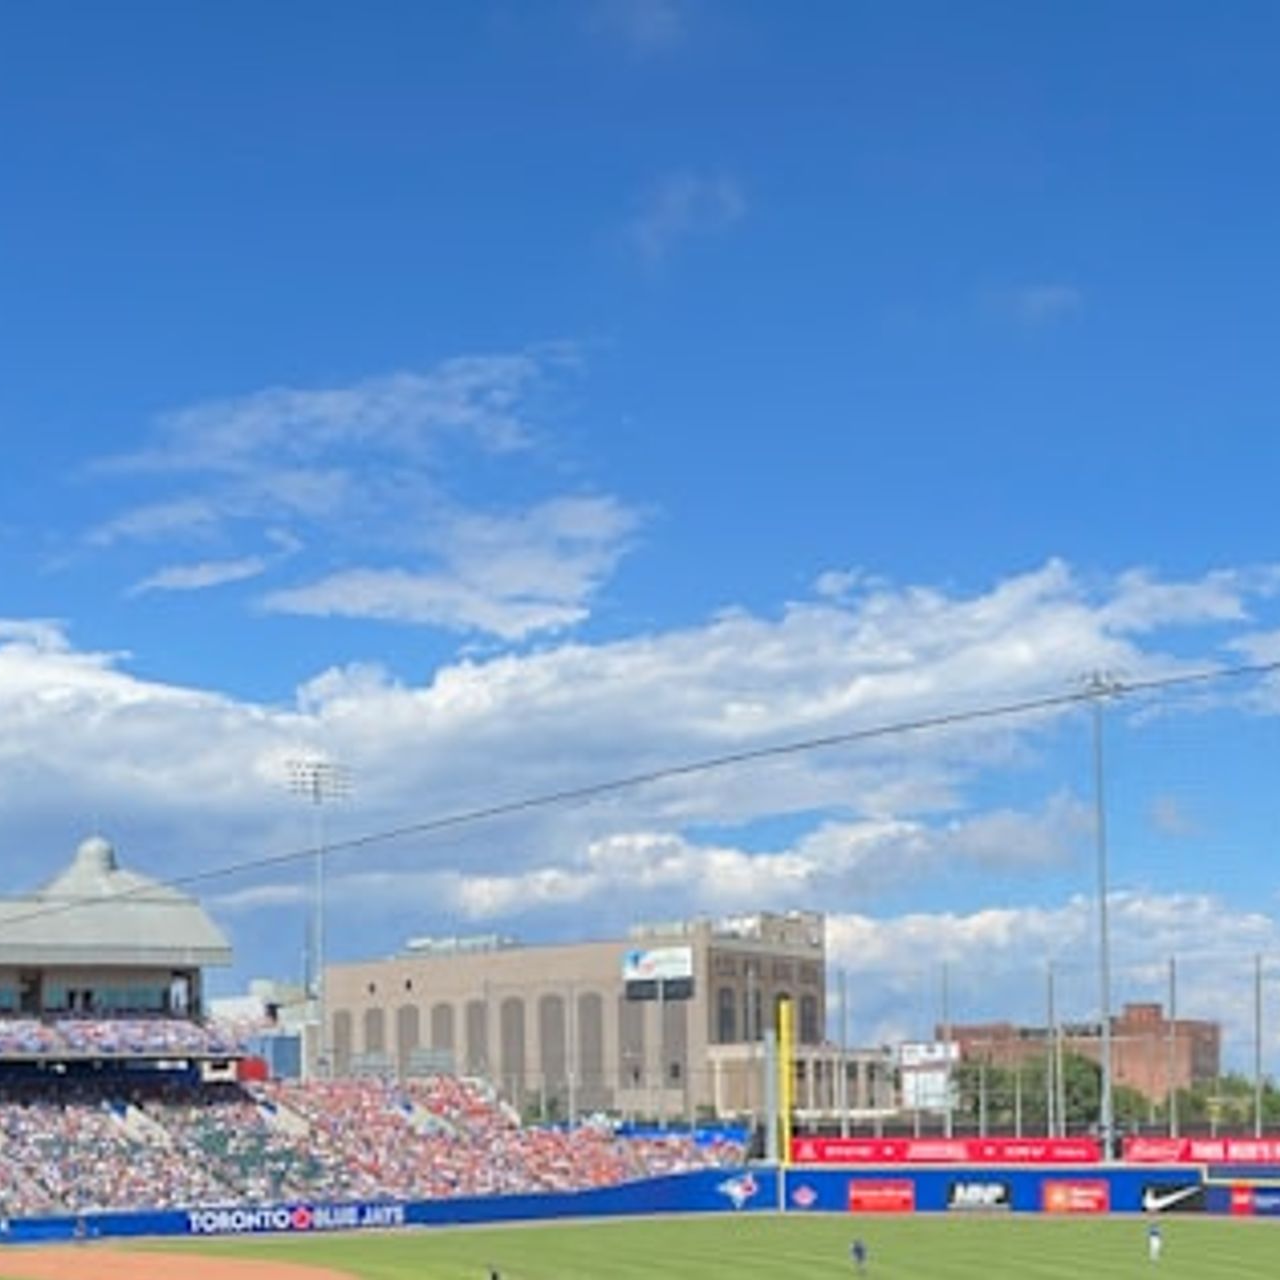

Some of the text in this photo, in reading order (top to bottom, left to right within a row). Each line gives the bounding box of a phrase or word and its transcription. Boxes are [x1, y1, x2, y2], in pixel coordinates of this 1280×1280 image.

[188, 1204, 404, 1233] TORONTO BLUE JAYS
